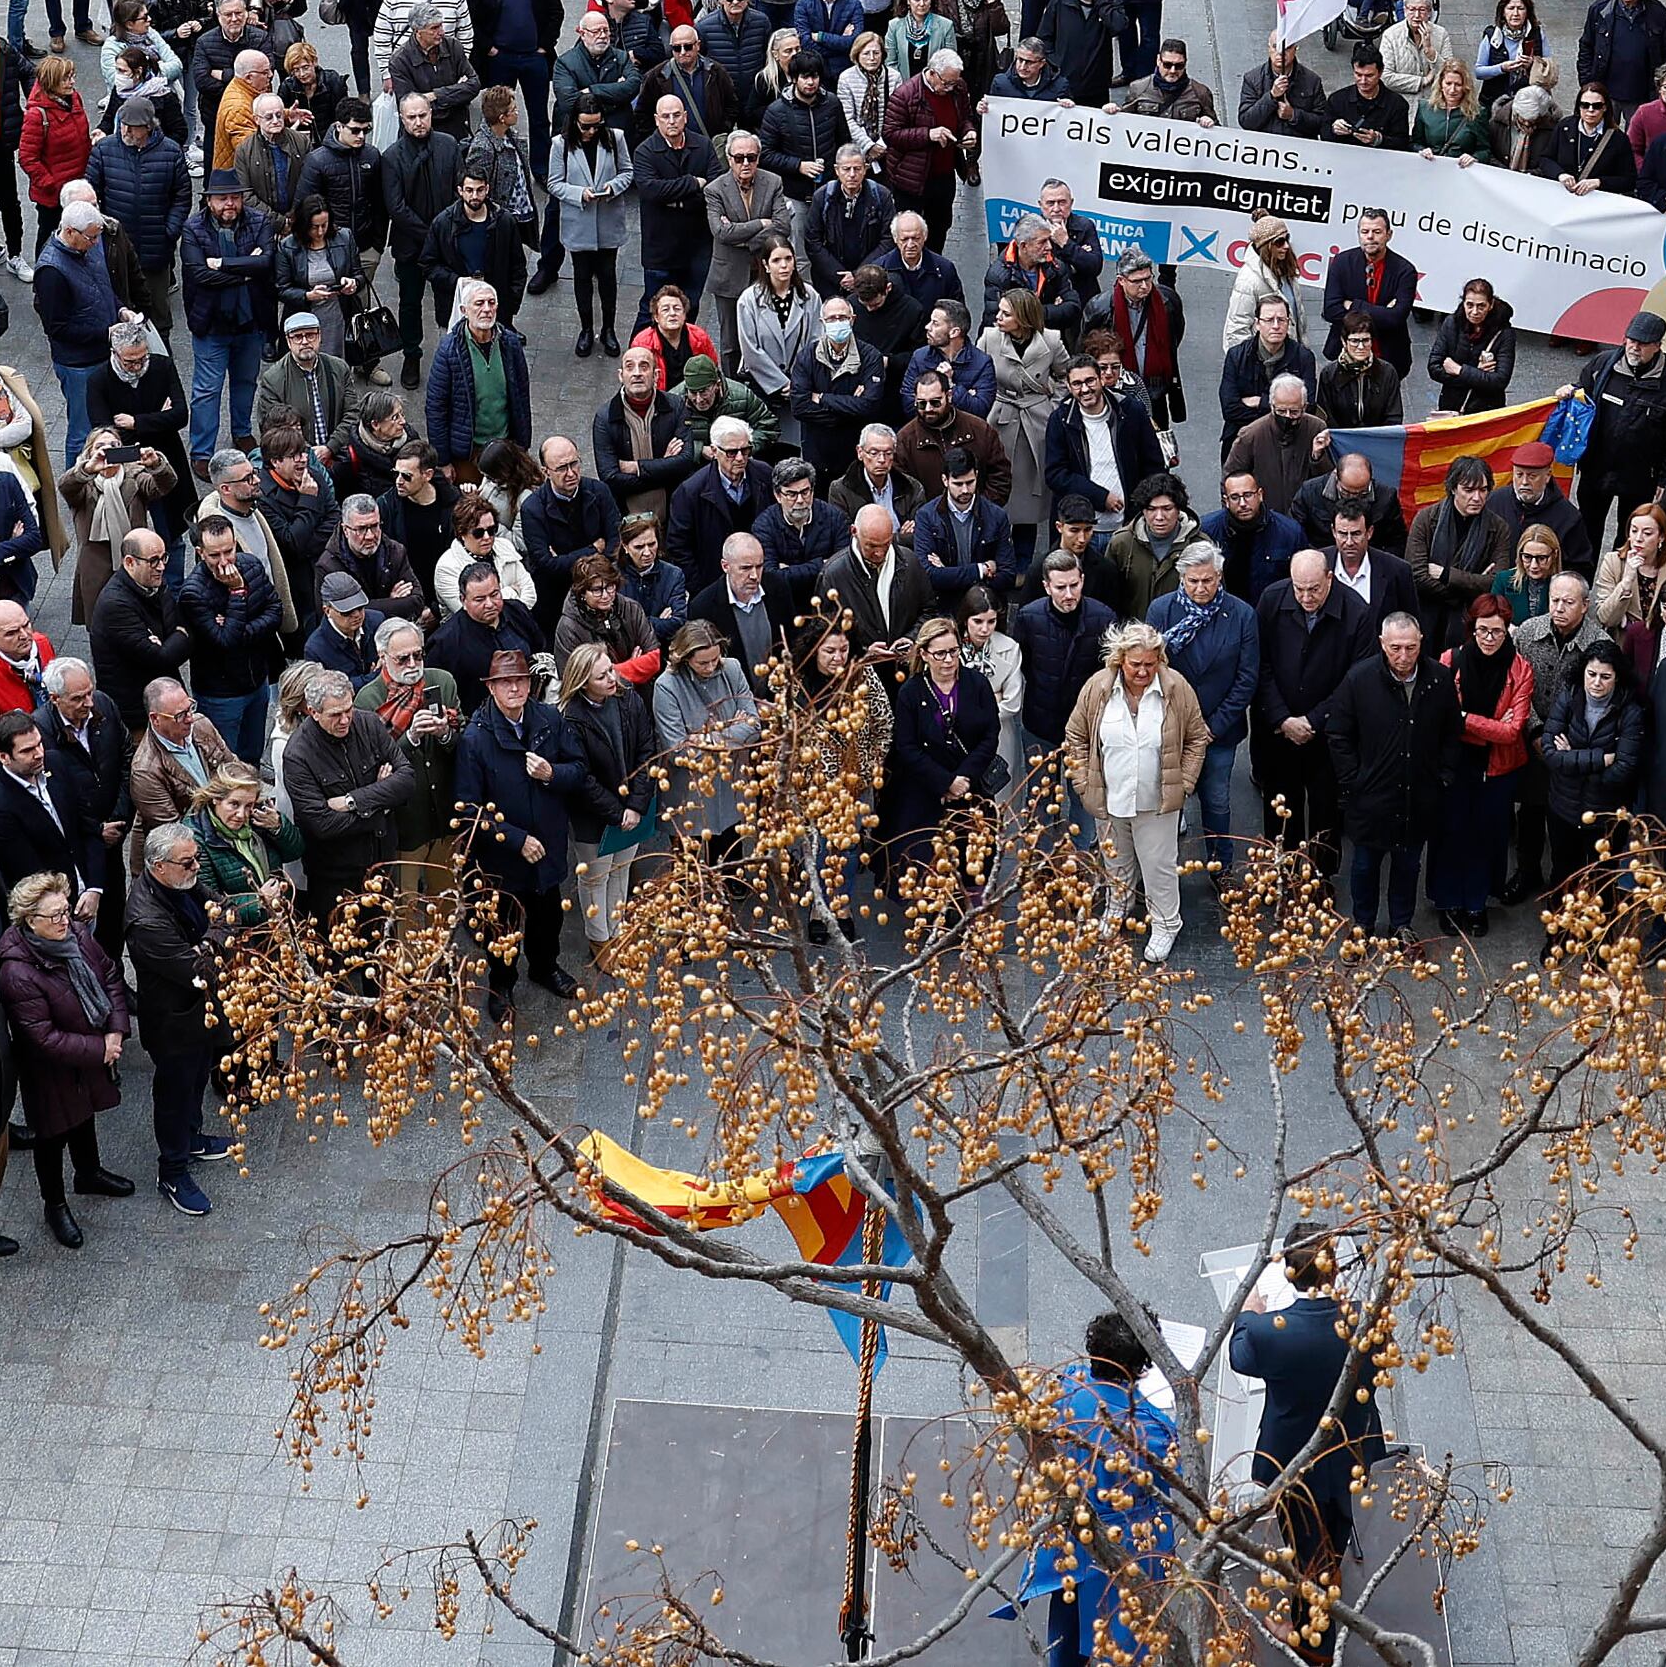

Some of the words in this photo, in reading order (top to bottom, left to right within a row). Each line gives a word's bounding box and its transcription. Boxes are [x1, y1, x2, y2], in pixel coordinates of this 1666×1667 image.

[1000, 112, 1056, 138] per
[1067, 118, 1112, 145] als
[1125, 128, 1334, 176] valencians...
[1109, 170, 1201, 201] exigim
[1213, 183, 1330, 221] dignitat,
[1342, 203, 1407, 228] pru
[1418, 210, 1452, 236] de
[1462, 222, 1648, 278] discriminacio
